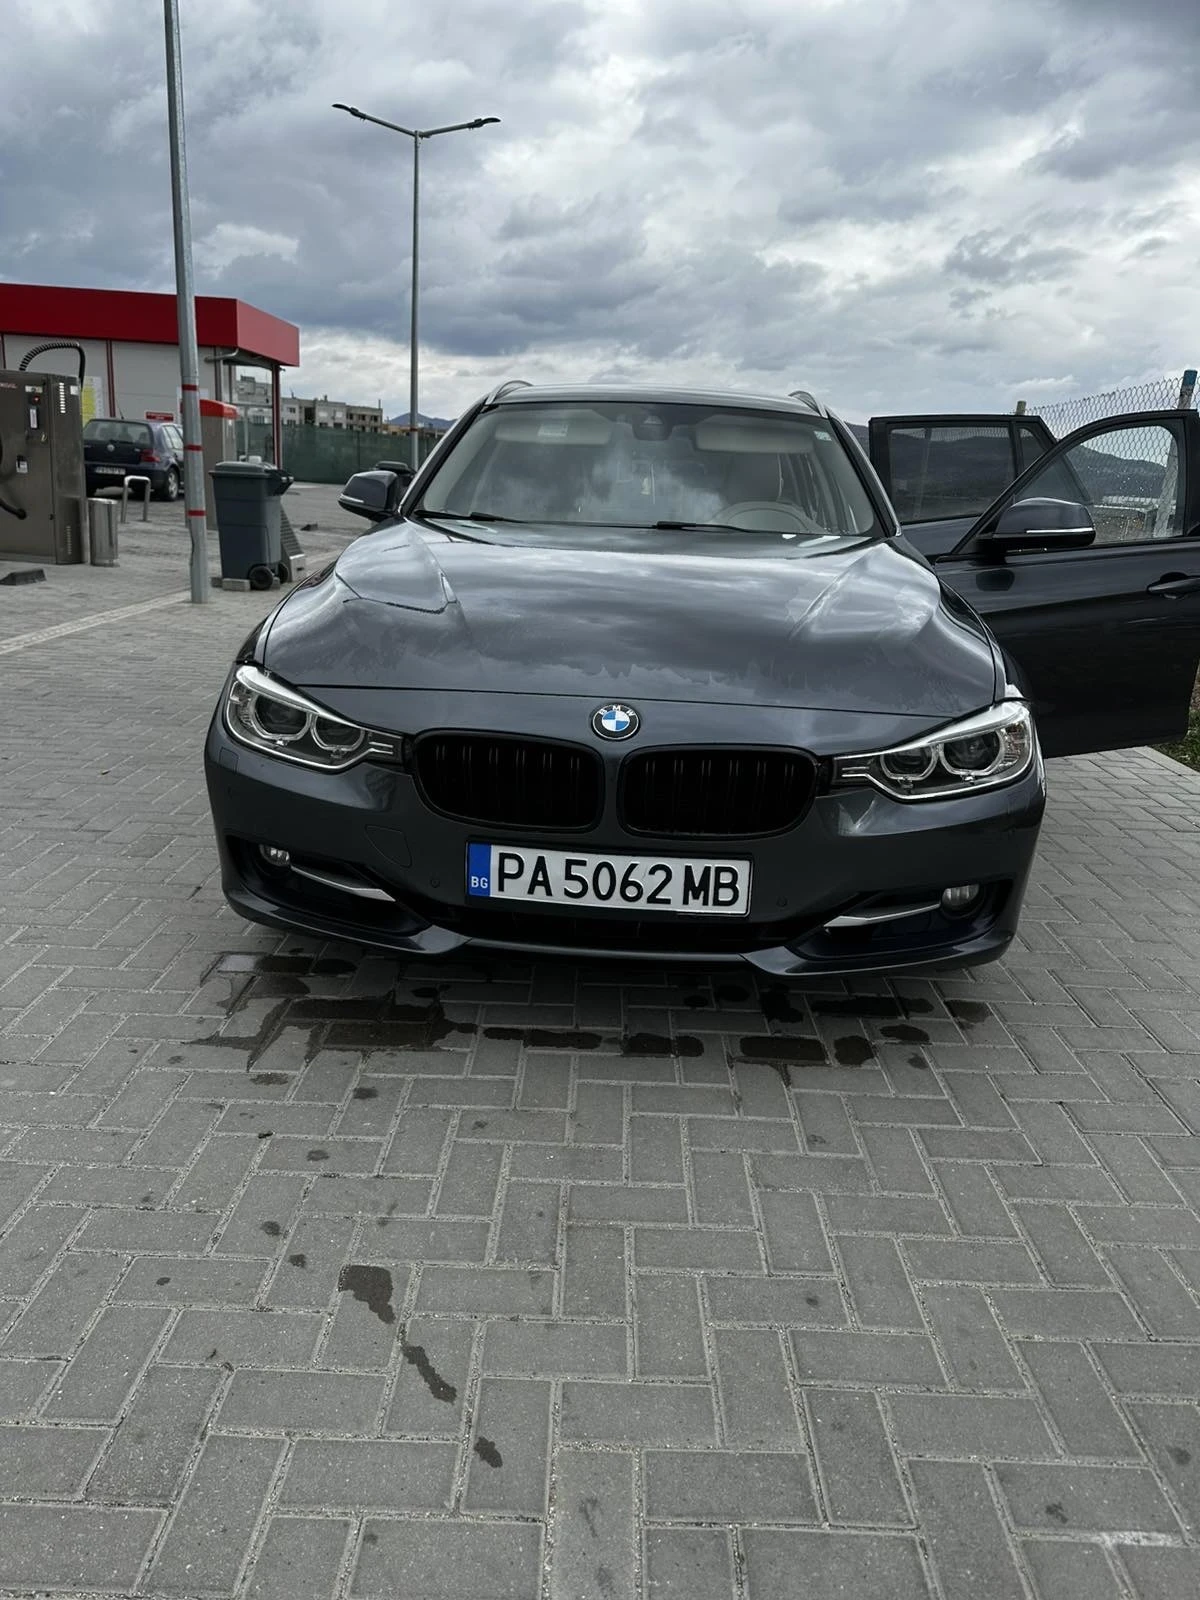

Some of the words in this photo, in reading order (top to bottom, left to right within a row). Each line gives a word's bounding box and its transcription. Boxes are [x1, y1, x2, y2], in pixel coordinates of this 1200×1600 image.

[599, 704, 636, 716] BMW
[471, 876, 488, 889] BG
[498, 852, 553, 896] PA
[563, 858, 673, 904] 5062
[682, 865, 740, 907] MB
